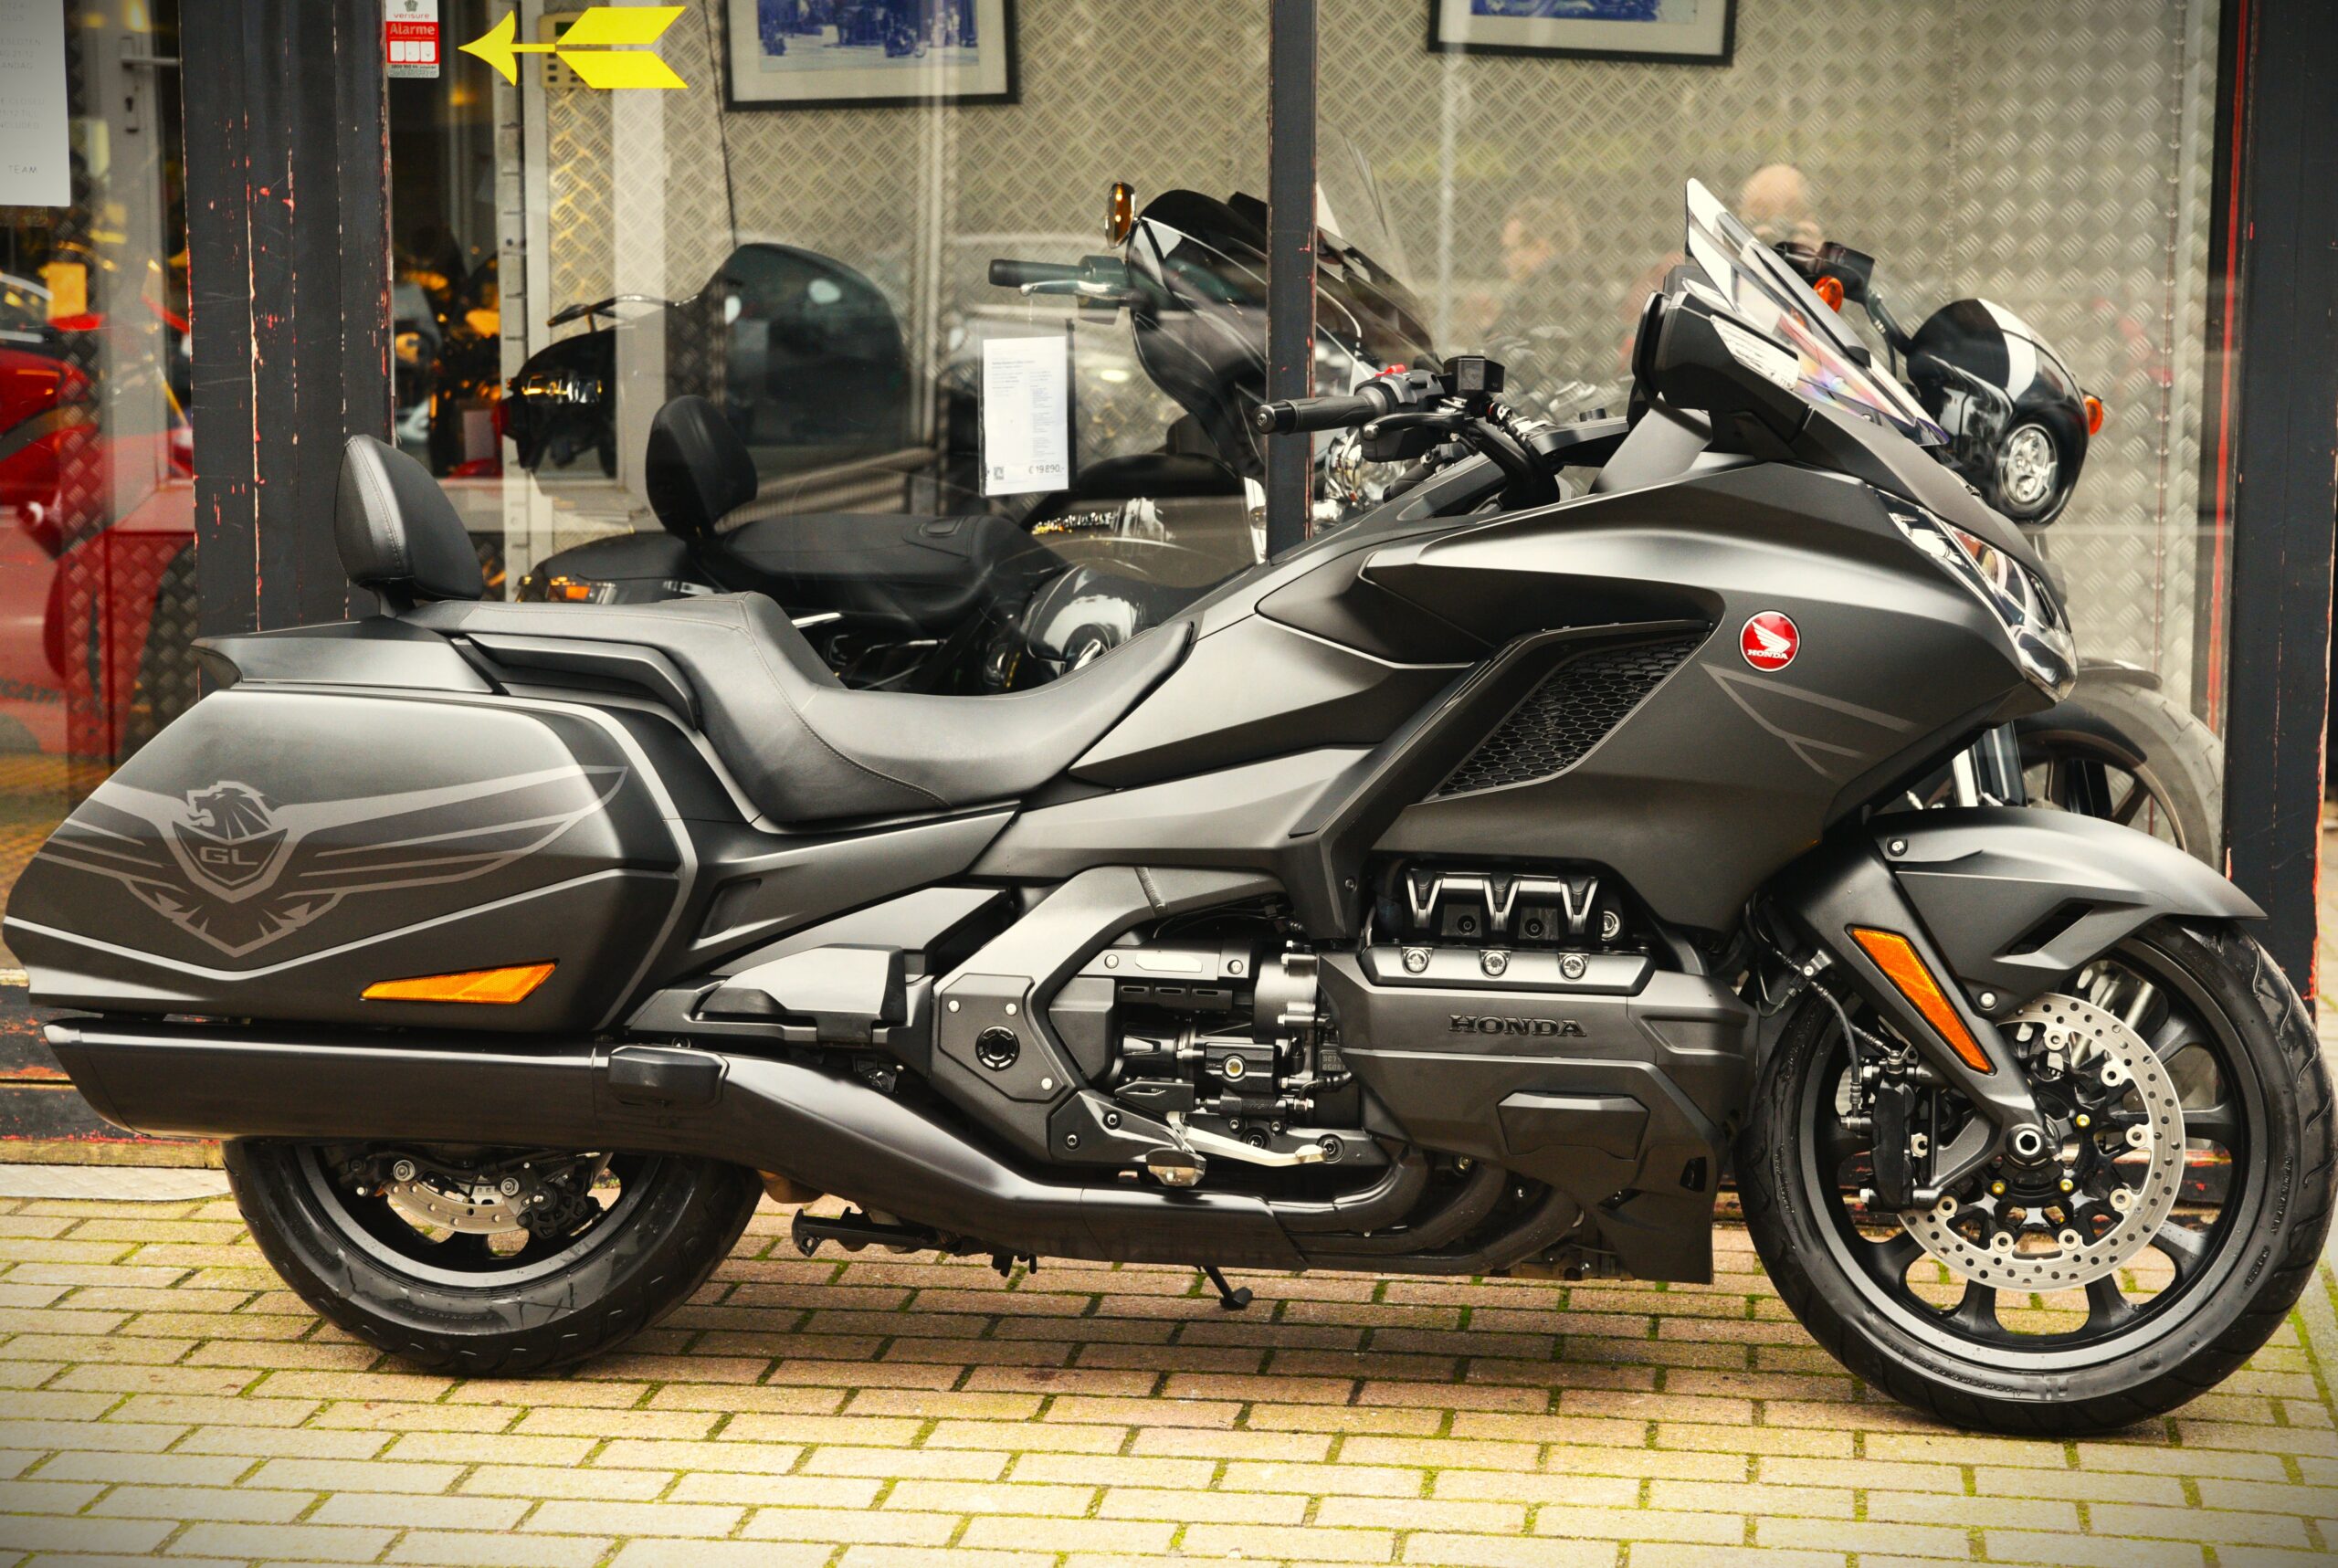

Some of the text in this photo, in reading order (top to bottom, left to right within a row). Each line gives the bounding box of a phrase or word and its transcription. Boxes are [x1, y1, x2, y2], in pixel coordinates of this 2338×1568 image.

[390, 23, 435, 35] Alarme
[8, 164, 37, 174] TEAM
[1747, 648, 1789, 660] HONDA
[200, 846, 258, 866] GL
[1448, 1015, 1587, 1037] HONDA
